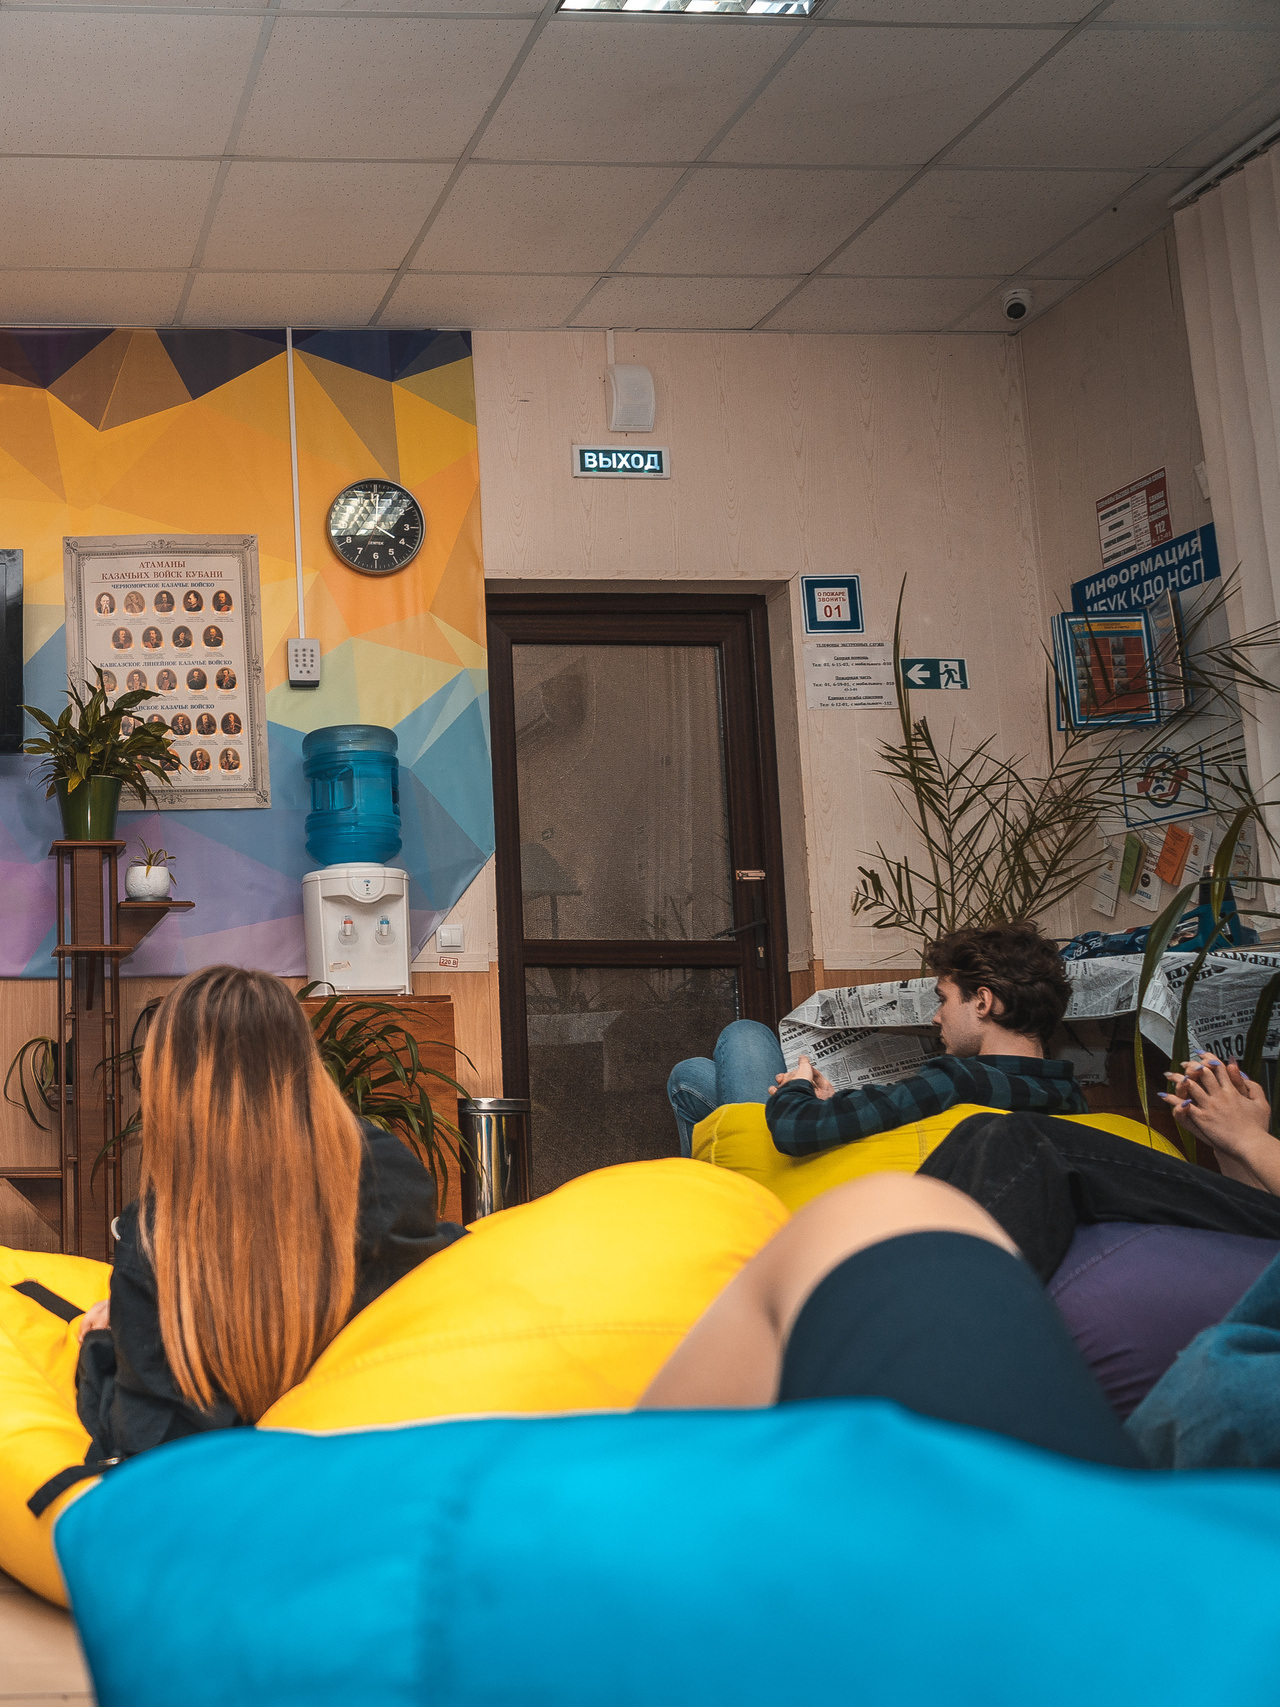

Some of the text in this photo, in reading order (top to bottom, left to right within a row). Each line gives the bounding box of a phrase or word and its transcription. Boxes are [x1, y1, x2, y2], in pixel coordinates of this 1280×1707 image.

[584, 452, 660, 470] ВЫХОД
[1154, 520, 1166, 535] 112
[389, 548, 394, 556] 5
[139, 561, 186, 569] АТАМАНЫ
[1085, 536, 1202, 600] ИНФОРМАЦИЯ
[101, 570, 223, 580] КАЗАЧЬИХ ВОЙСК КУБАНИ
[111, 582, 160, 590] ЧЕРНОМОРСКОЕ
[1131, 576, 1164, 605] КДО
[1168, 559, 1204, 588] НСП
[823, 605, 842, 618] 01
[100, 661, 141, 669] КАВКАЗСКОЕ
